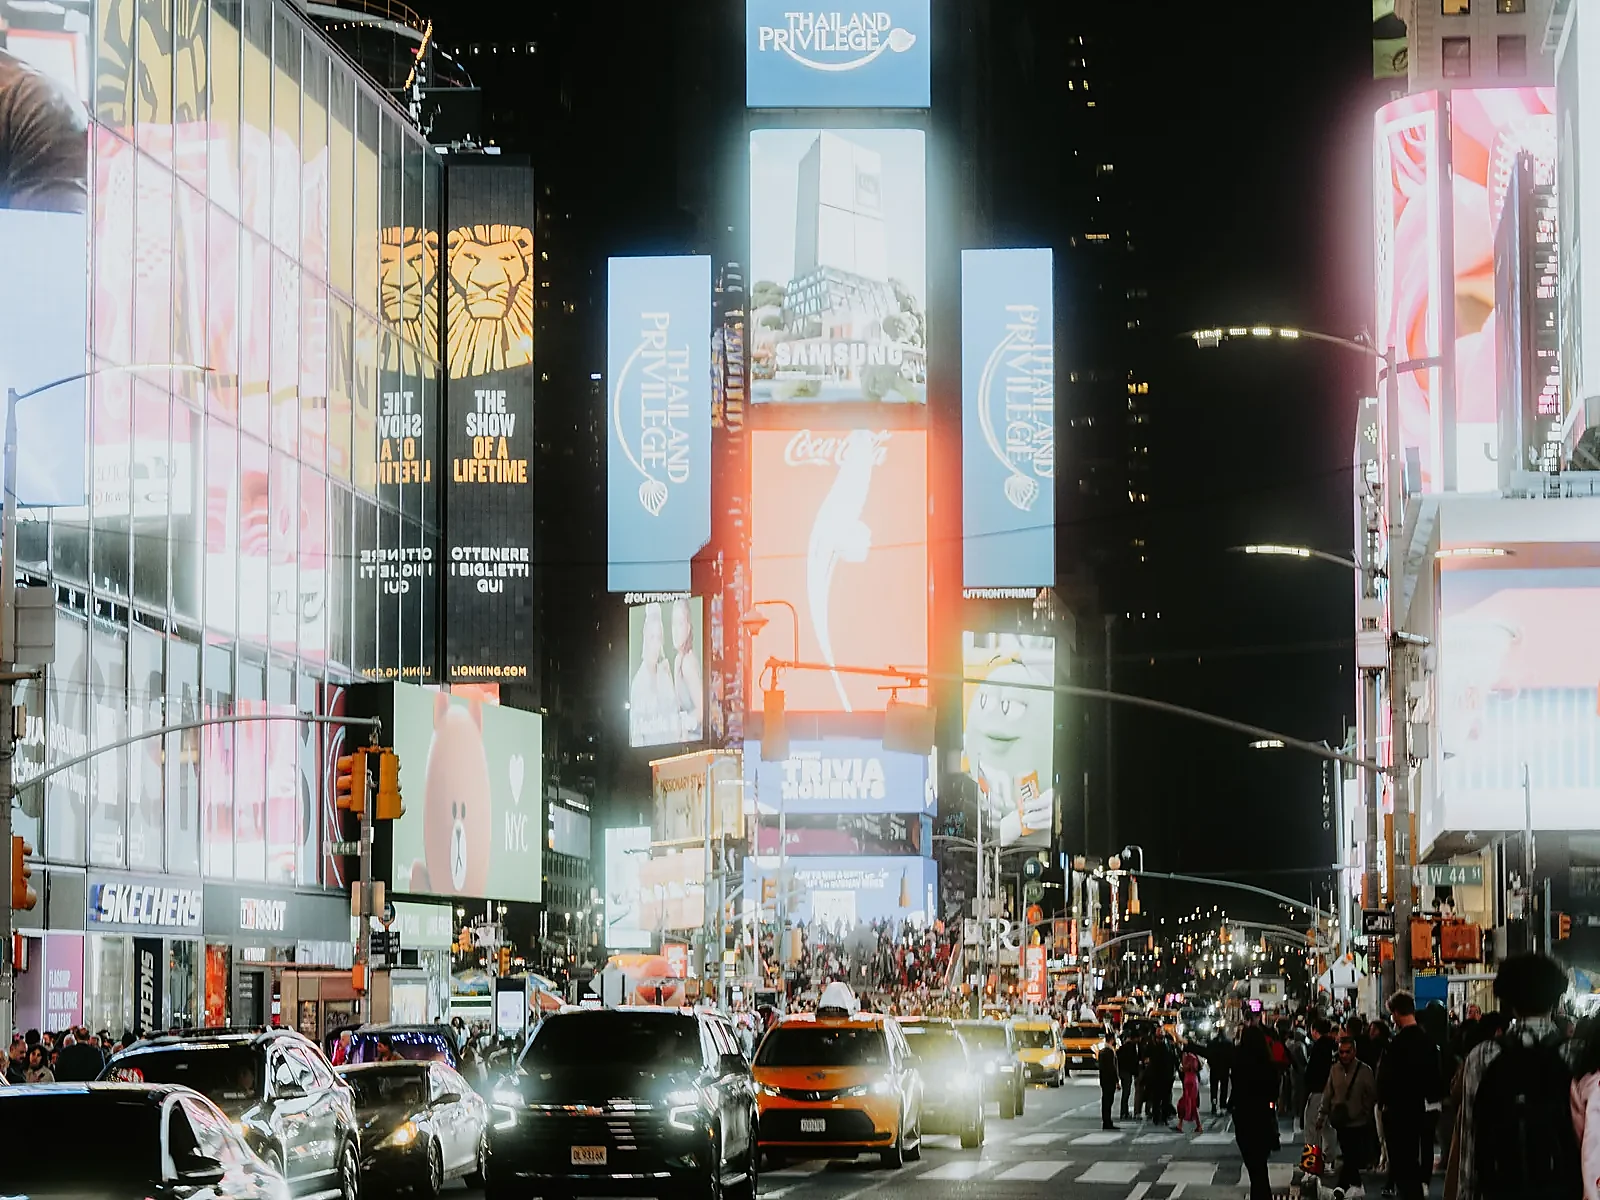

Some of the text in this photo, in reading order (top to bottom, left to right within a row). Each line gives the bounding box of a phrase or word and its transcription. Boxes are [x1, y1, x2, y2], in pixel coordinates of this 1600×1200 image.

[785, 12, 891, 31] THAILAND
[759, 27, 880, 51] PRIVILEGE
[776, 343, 902, 365] SAMSUNG
[641, 312, 669, 470] PRIVILEGE
[1005, 304, 1039, 463] PRIVILEGE
[475, 390, 507, 414] THE
[667, 343, 690, 483] THAILAND
[466, 413, 515, 437] SHOW
[473, 436, 509, 459] OF A
[453, 459, 528, 483] LIFETIME
[451, 547, 529, 562] OTTENERE
[451, 563, 529, 578] I BIGLIETTI
[476, 579, 503, 594] QUI
[451, 665, 527, 677] LIONKING.COM
[782, 758, 884, 782] TRIVIA
[782, 779, 885, 799] MOMENTS
[505, 810, 528, 852] NYC
[1430, 867, 1442, 883] W
[1449, 867, 1465, 884] 44
[101, 883, 202, 926] SKECHERS
